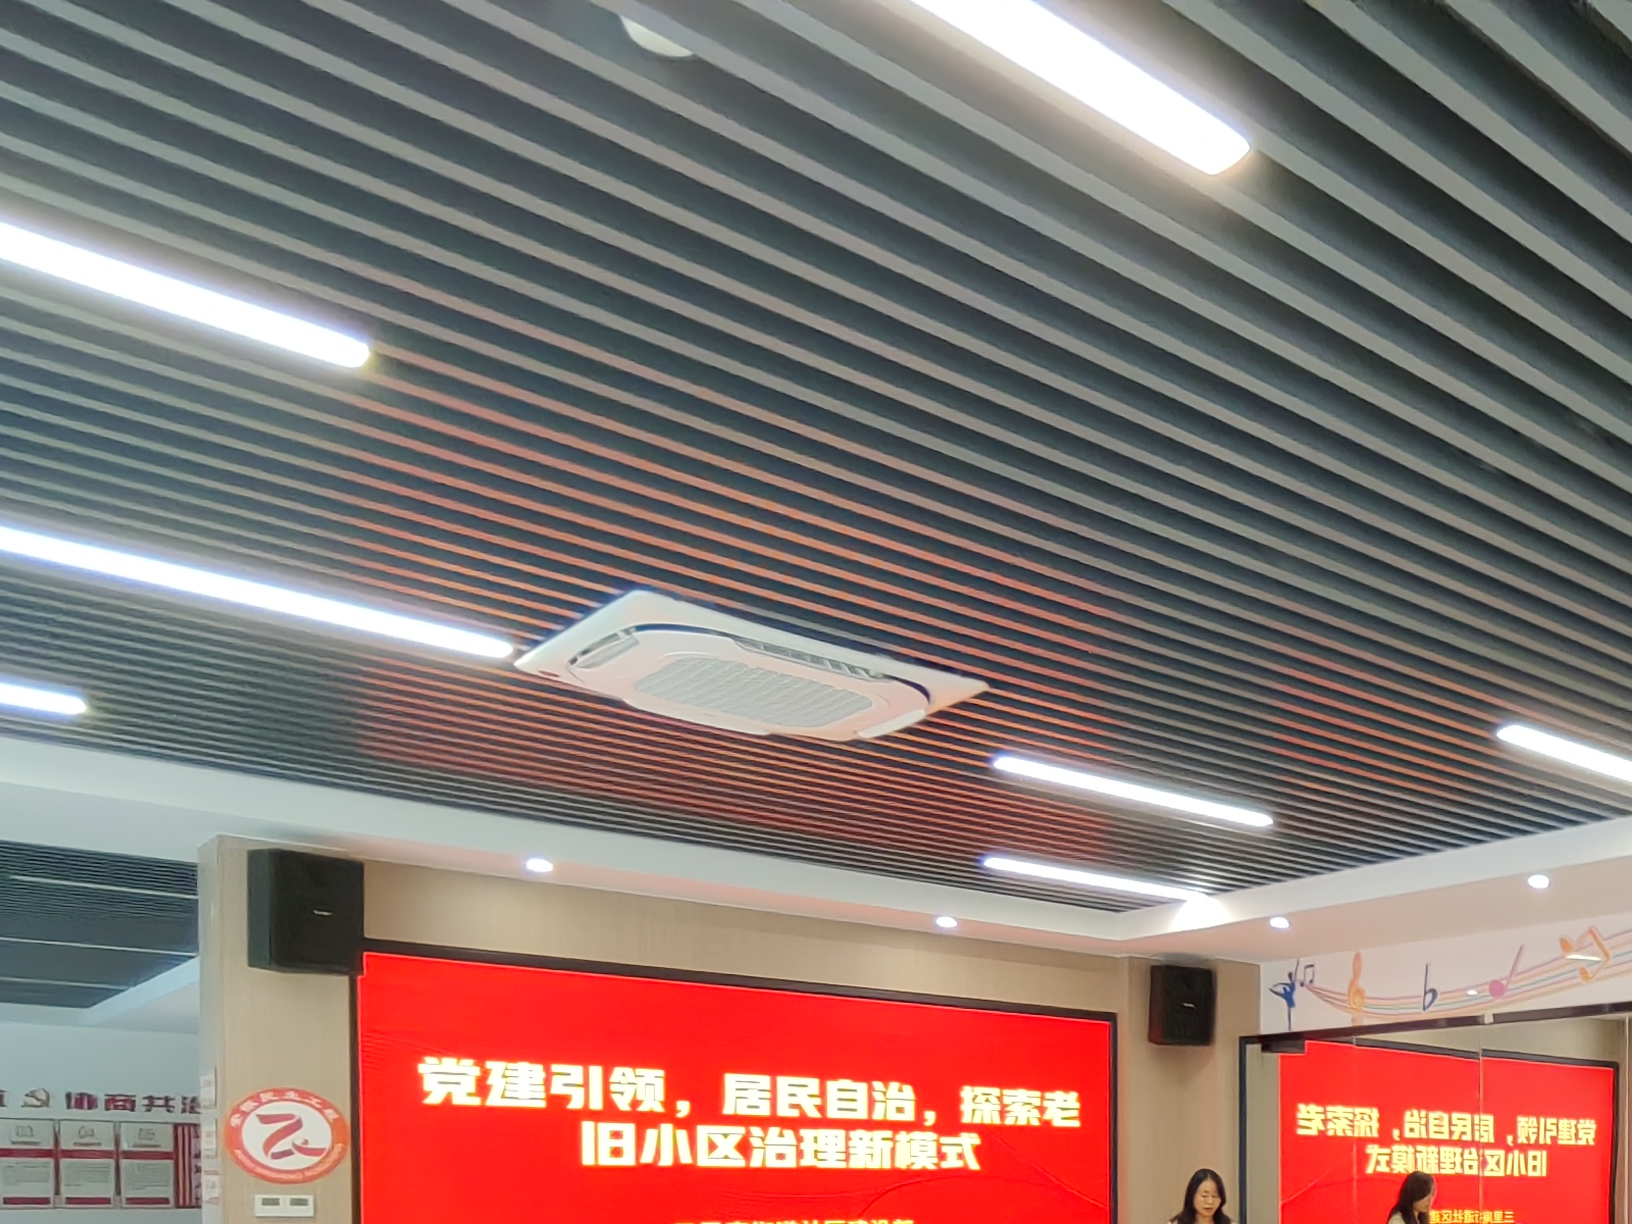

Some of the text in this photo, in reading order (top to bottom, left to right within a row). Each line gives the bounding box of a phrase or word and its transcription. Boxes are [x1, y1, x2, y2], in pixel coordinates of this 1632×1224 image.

[418, 1056, 1082, 1129] 党建引领，居民自治，探索老
[580, 1121, 982, 1171] 旧小区治理新模式
